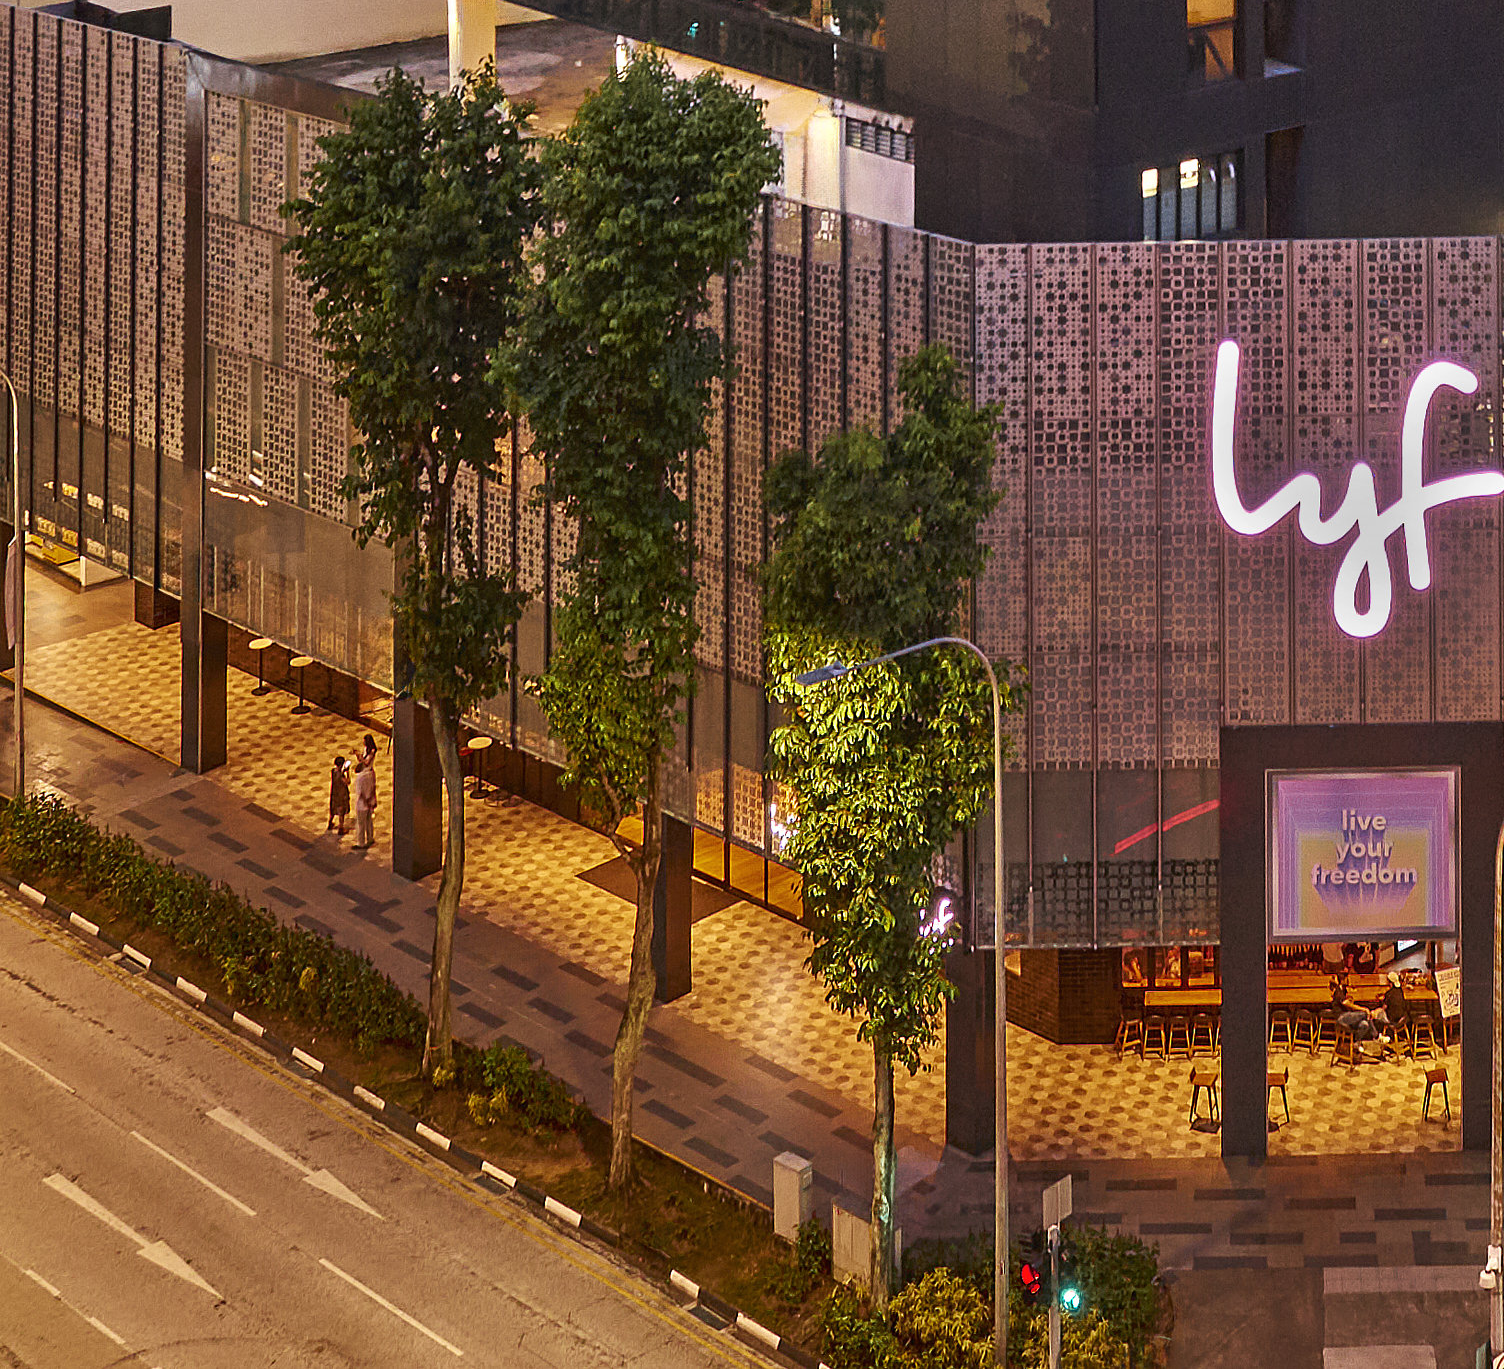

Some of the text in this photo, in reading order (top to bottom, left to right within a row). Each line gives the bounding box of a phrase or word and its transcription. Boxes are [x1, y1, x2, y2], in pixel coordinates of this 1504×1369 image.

[1341, 809, 1387, 831] live
[1336, 840, 1394, 864] your
[1311, 863, 1418, 885] freedom
